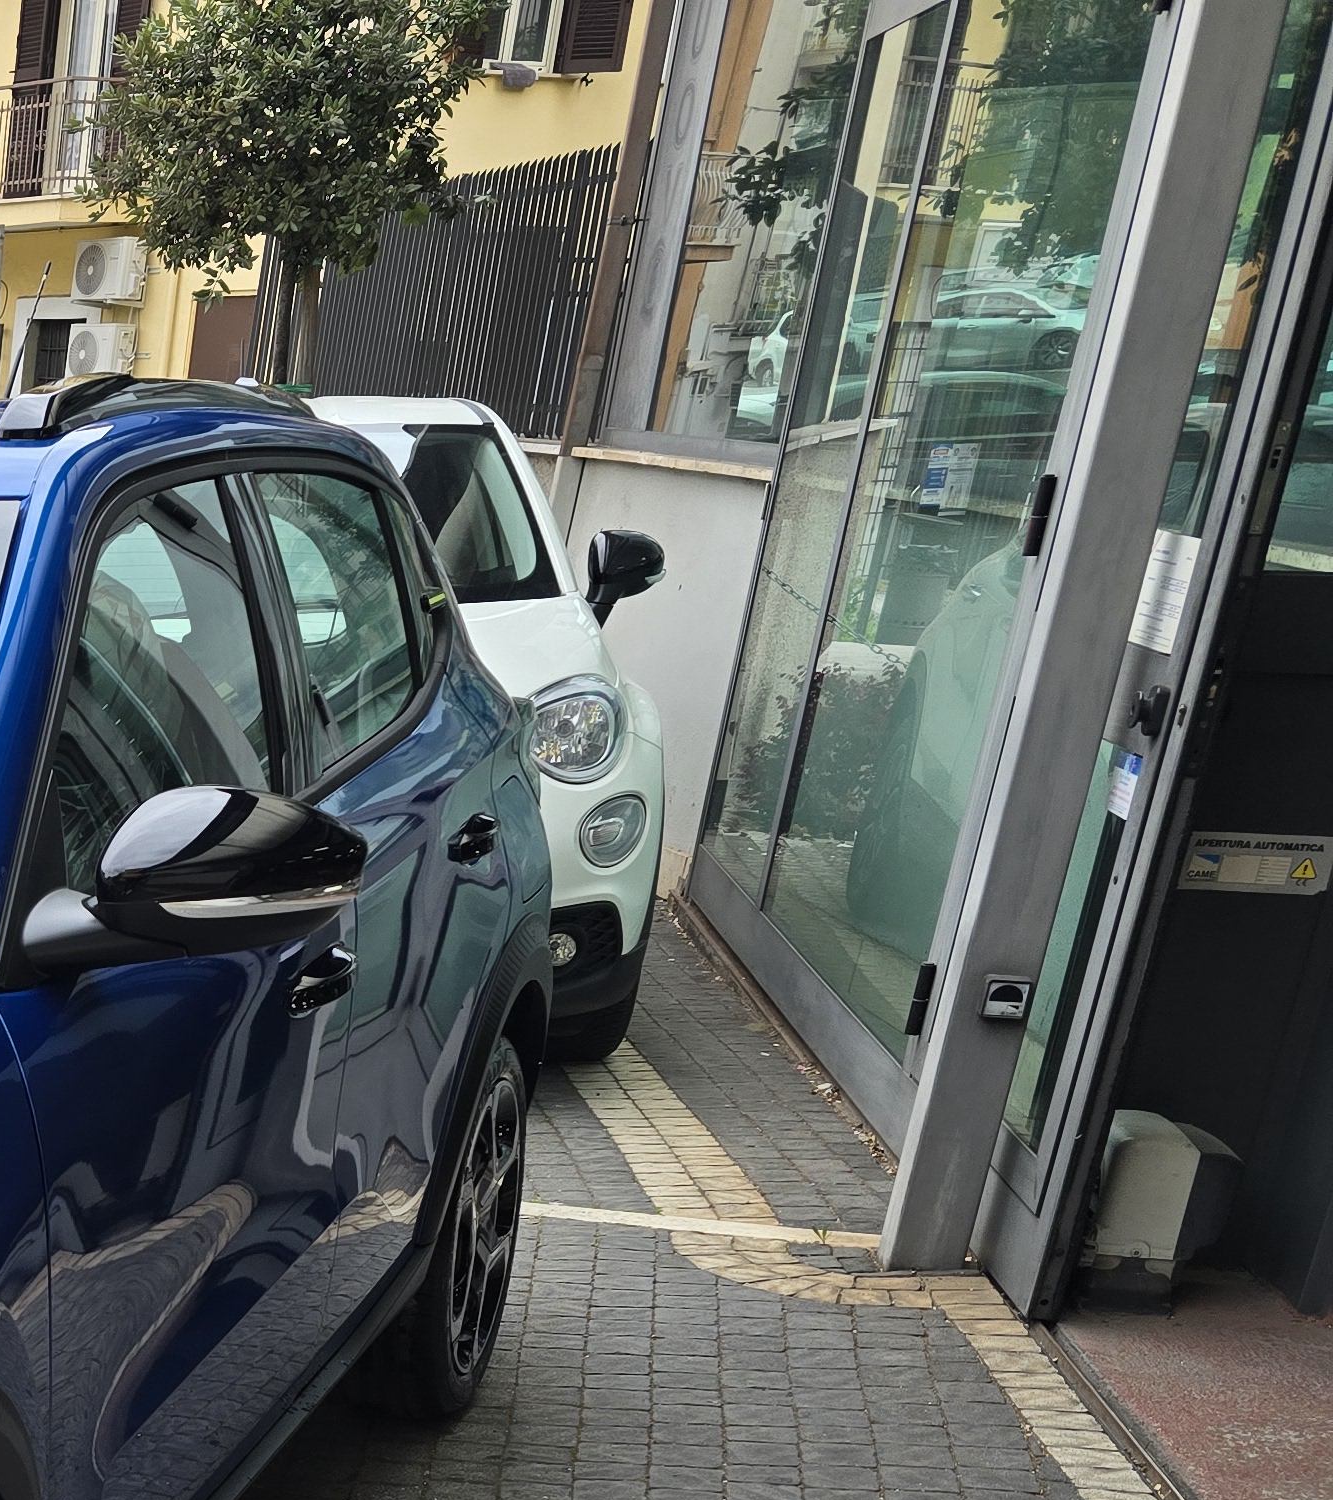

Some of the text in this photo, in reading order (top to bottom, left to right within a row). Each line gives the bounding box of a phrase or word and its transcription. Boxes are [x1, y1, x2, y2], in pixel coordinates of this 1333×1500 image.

[1195, 838, 1325, 853] APERTURA AUTOMATICA
[1187, 869, 1217, 879] CAME
